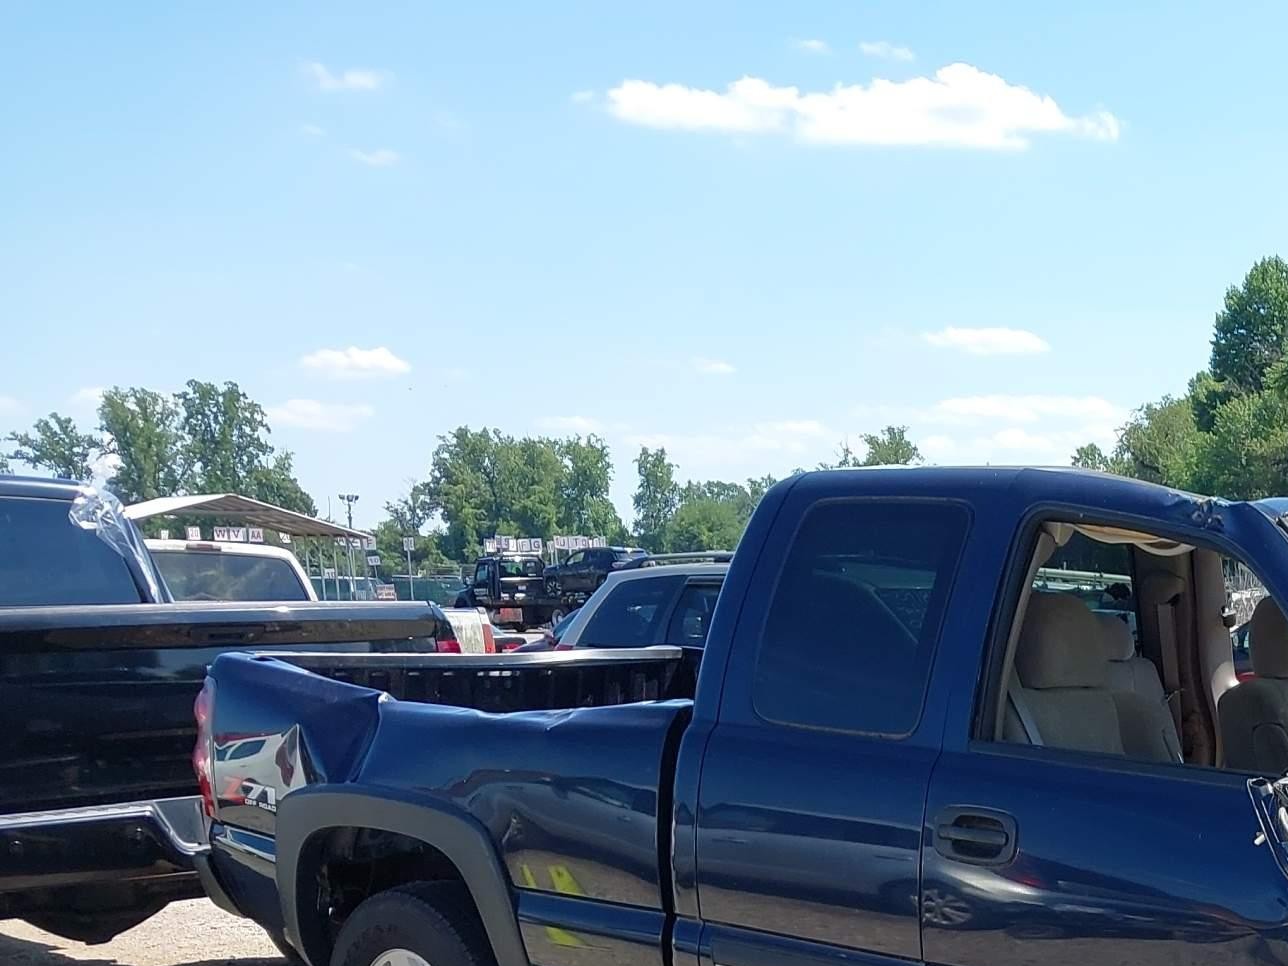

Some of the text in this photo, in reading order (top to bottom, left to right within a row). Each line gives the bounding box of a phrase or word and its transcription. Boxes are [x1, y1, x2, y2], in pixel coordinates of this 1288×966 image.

[215, 529, 226, 538] W
[251, 531, 262, 540] AA
[223, 776, 276, 805] Z71
